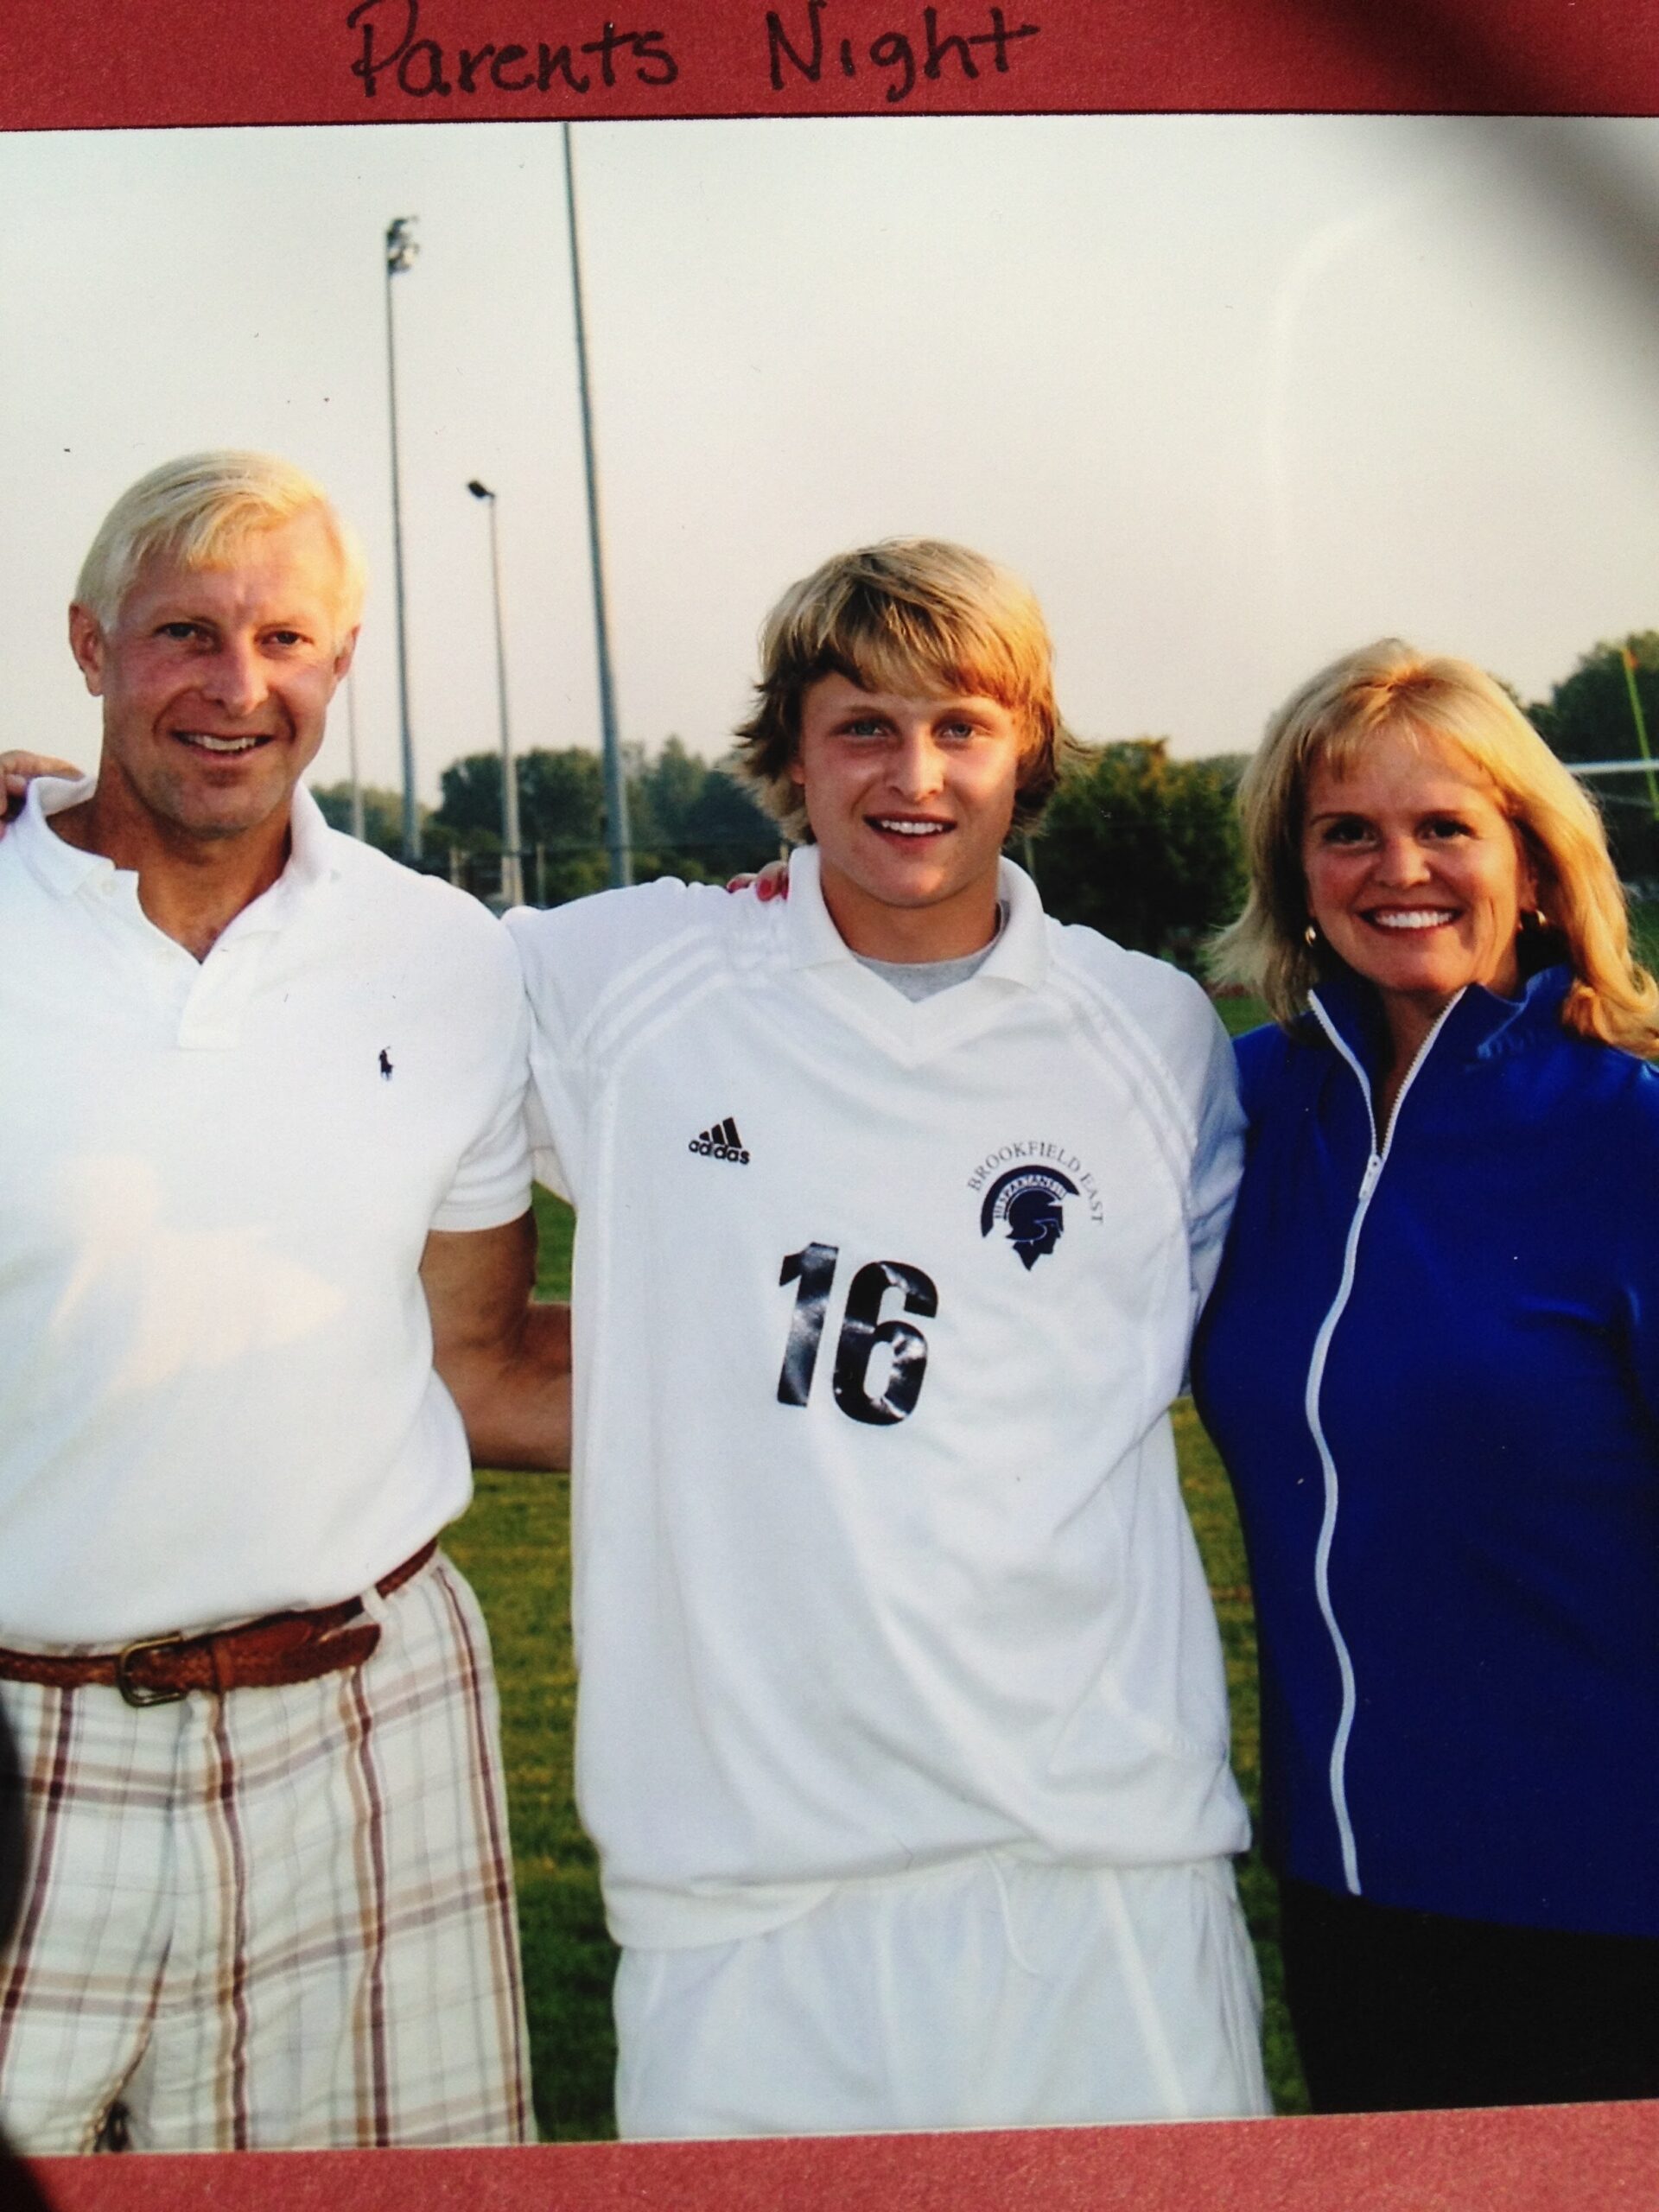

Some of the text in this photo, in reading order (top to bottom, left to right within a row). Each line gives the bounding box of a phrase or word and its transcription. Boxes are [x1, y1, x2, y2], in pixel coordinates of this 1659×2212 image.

[347, 0, 1039, 103] Parents Night
[689, 1140, 750, 1165] adidas
[968, 1141, 1104, 1224] BROOKFIELD EAST
[777, 1242, 938, 1426] 16
